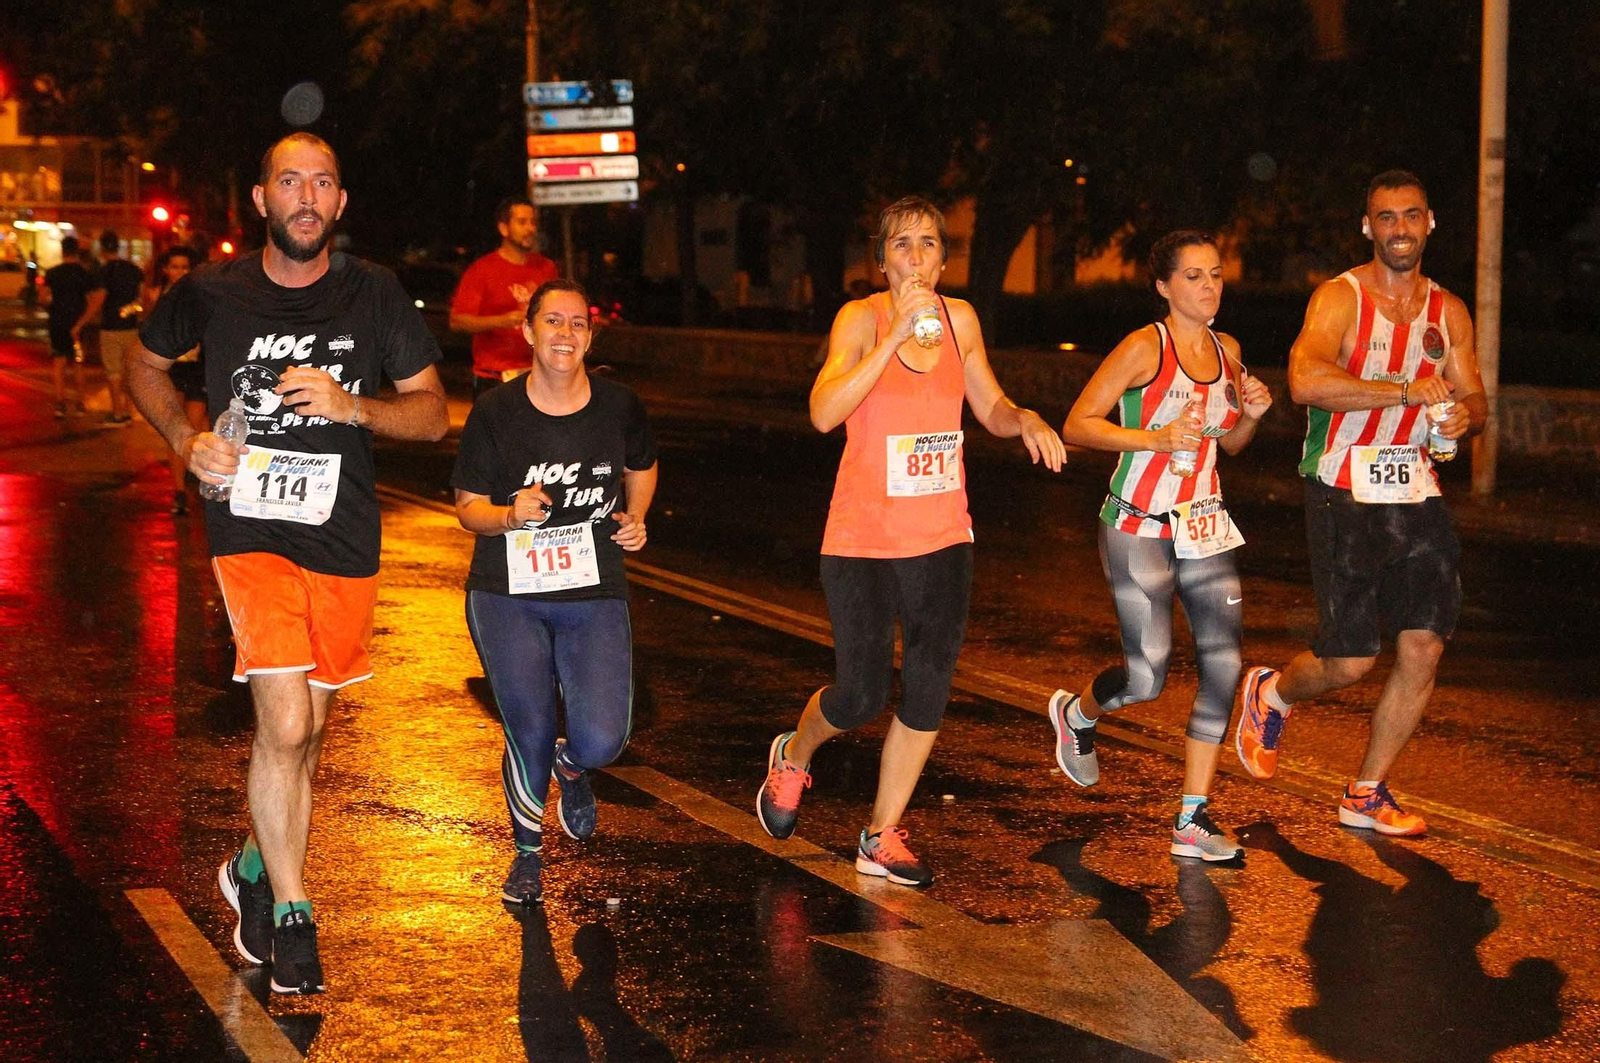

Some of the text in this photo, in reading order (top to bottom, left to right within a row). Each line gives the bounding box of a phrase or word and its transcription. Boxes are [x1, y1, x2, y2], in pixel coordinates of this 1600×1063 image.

[247, 333, 316, 361] NOC
[914, 442, 957, 453] DE HUELVA
[915, 434, 958, 445] NOCTURNA
[267, 463, 283, 473] DE
[271, 455, 330, 467] NOCTURNA
[907, 452, 944, 477] 821
[1376, 455, 1388, 463] DE
[523, 461, 582, 486] NOC
[1369, 463, 1410, 485] 526
[257, 472, 308, 502] 114
[562, 487, 604, 508] TUR
[533, 526, 583, 540] NOCTURNA
[1186, 513, 1217, 541] 527
[547, 535, 582, 547] HUELVA
[526, 546, 572, 573] 115
